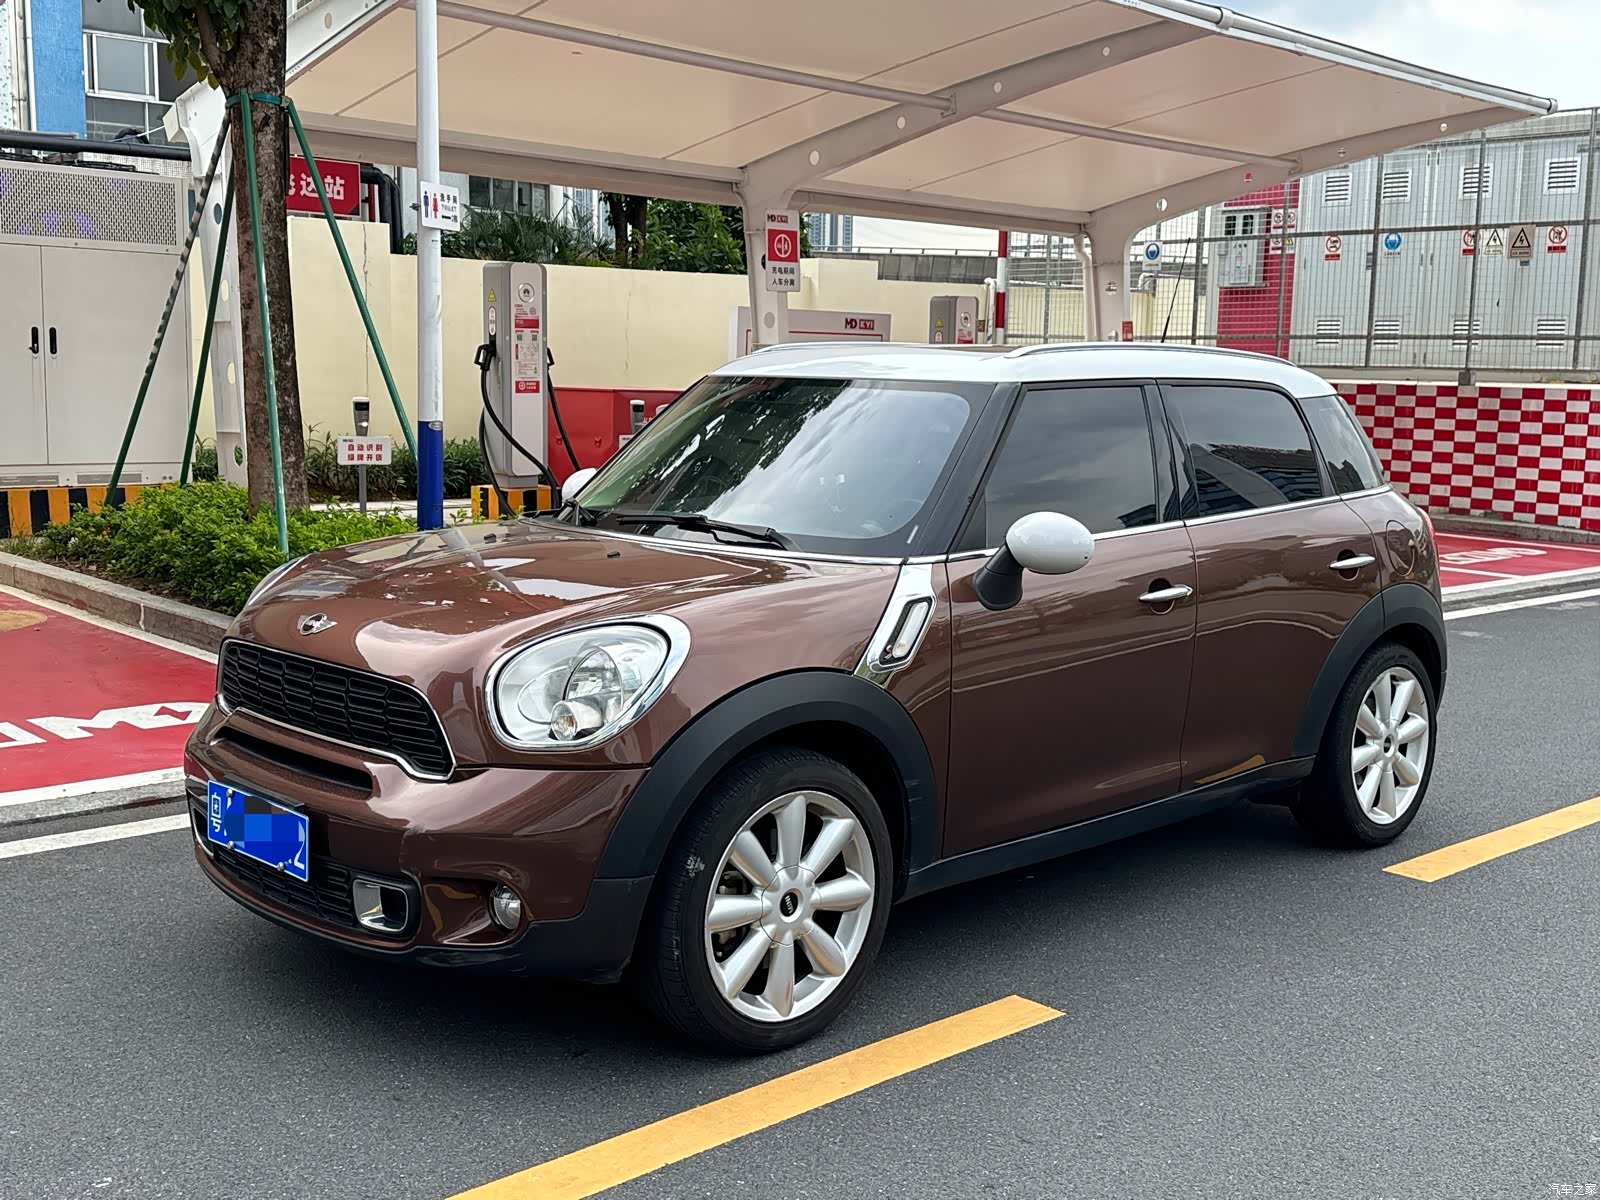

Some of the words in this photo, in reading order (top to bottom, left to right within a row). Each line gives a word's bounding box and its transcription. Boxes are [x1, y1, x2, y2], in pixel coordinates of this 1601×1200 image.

[771, 266, 795, 275] 充电期间
[771, 278, 795, 286] 人车分离
[347, 443, 383, 451] 自动识别
[347, 453, 383, 462] 绿牌开锁
